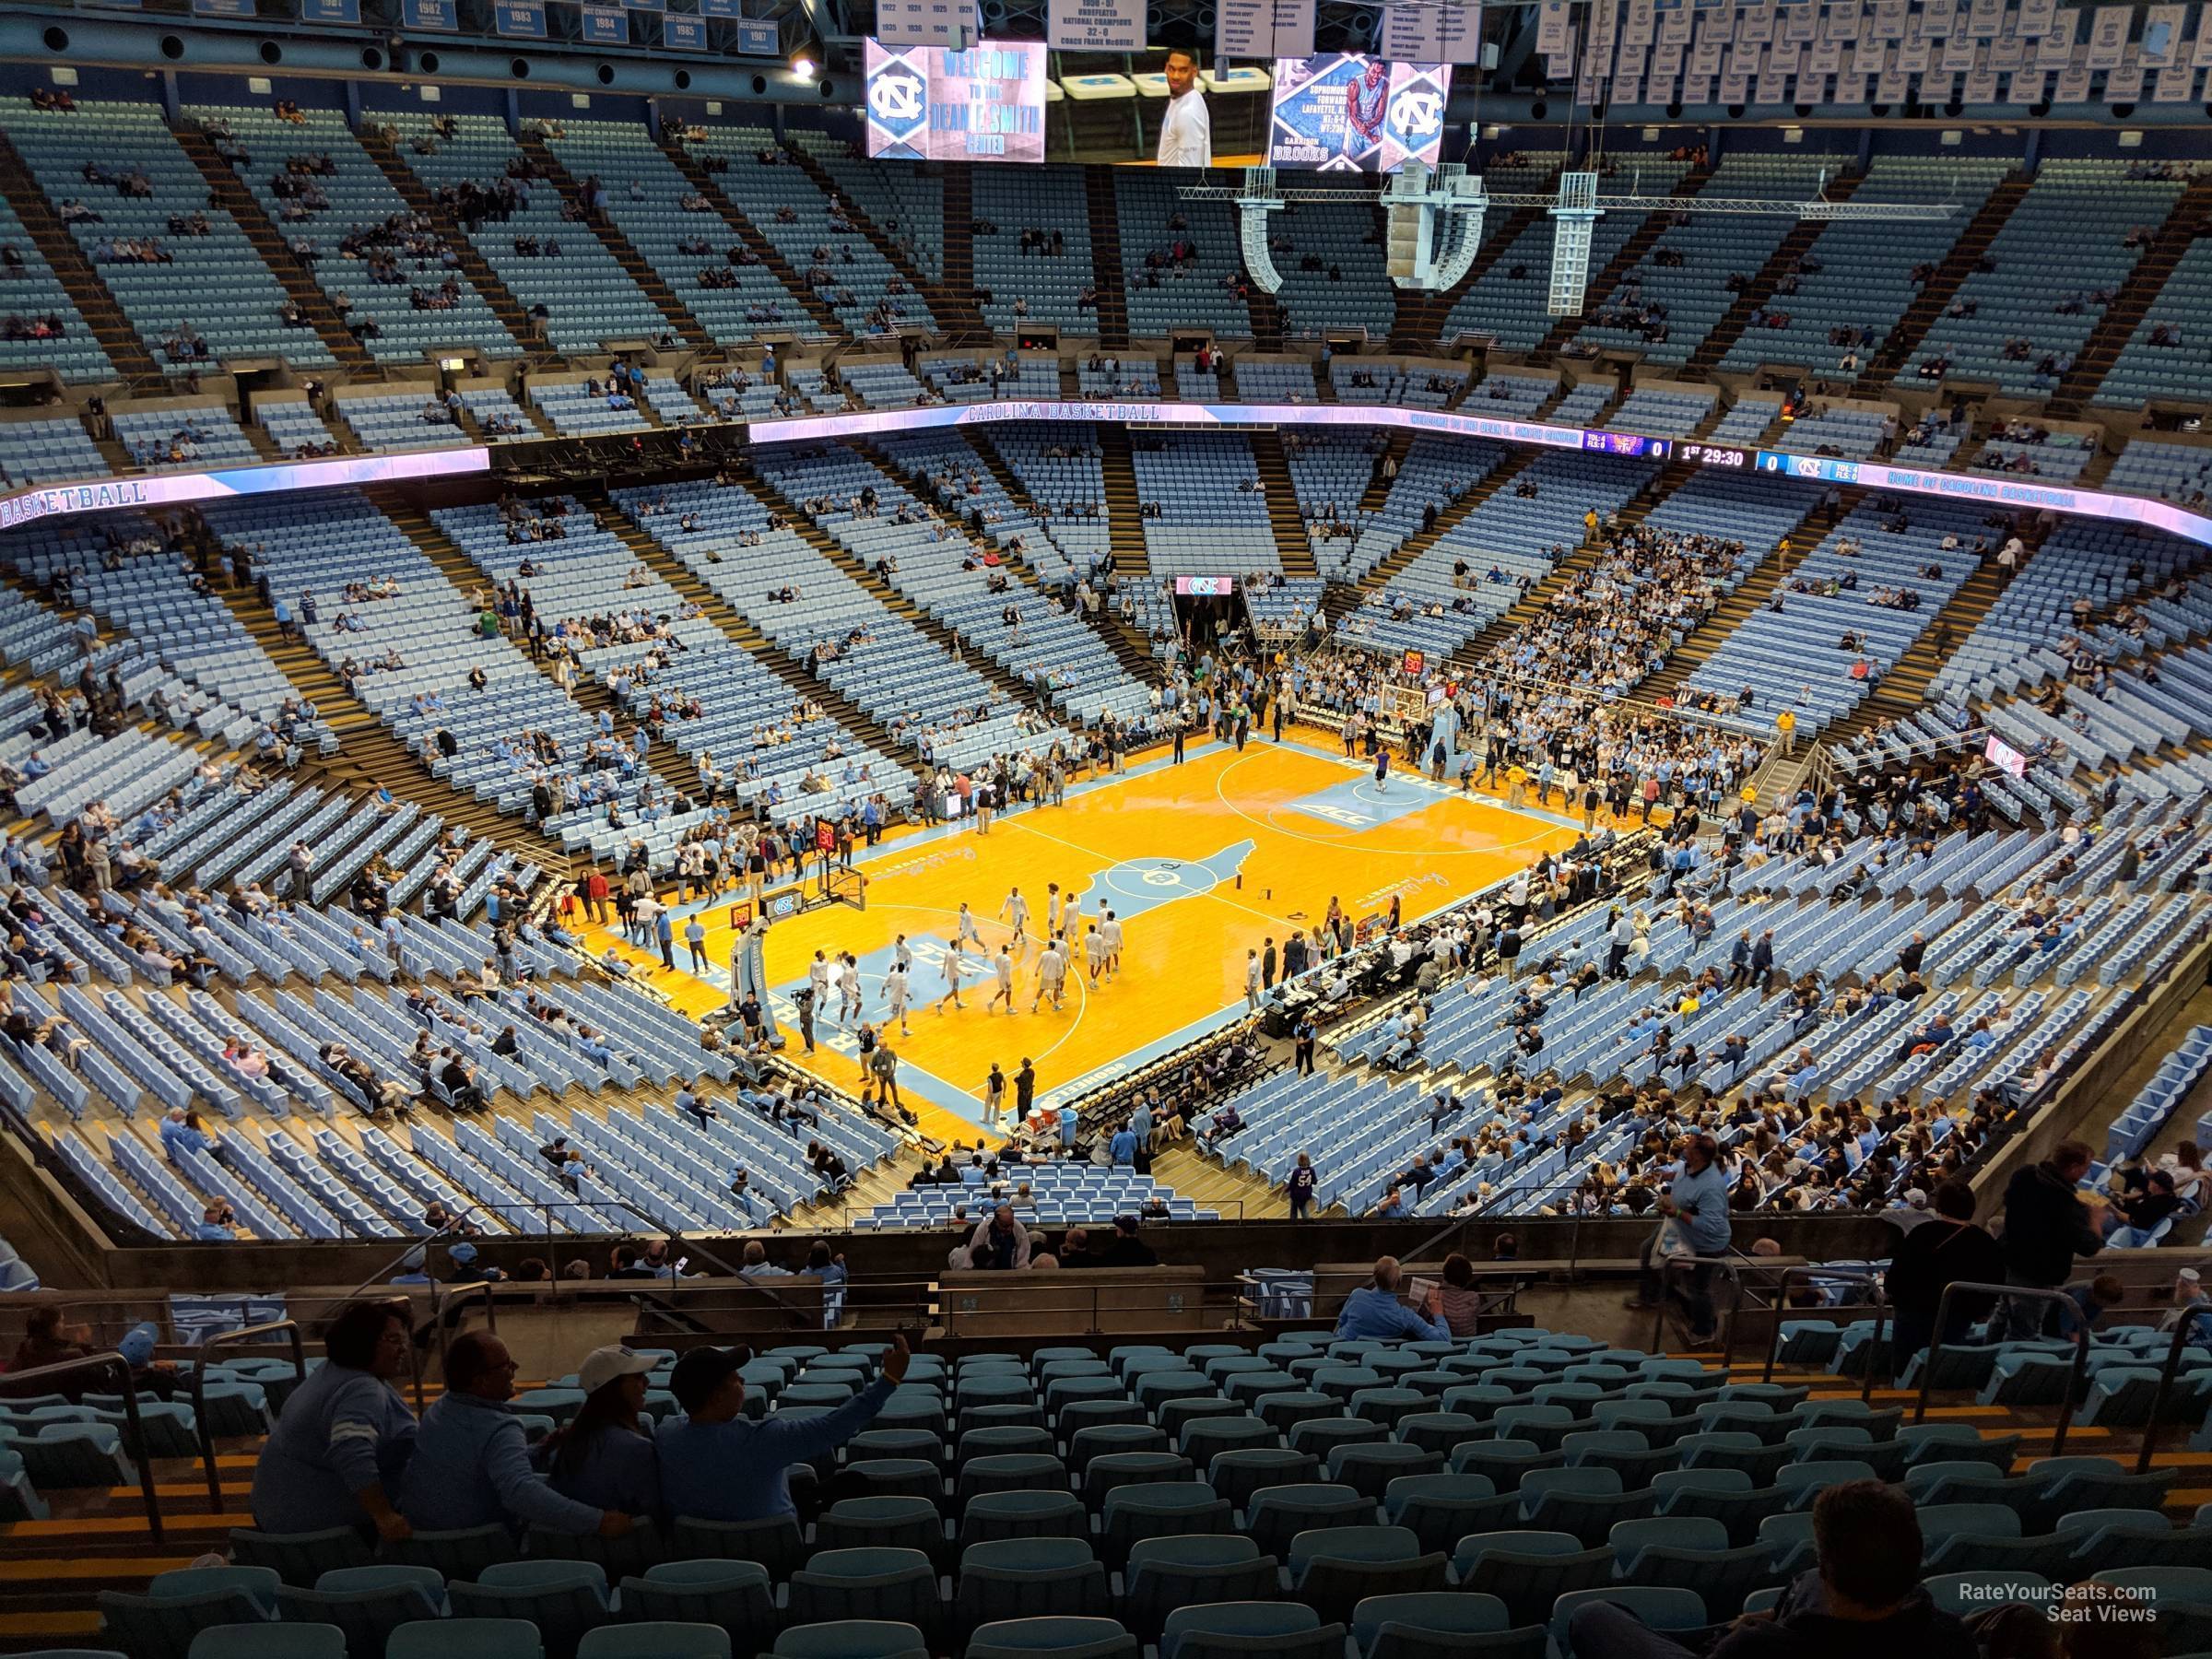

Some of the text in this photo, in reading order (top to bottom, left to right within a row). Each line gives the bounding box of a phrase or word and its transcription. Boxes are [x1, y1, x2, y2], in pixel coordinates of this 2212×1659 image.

[510, 11, 532, 22] 1983
[1078, 8, 1117, 17] UNDEFEATED
[595, 18, 615, 29] 1984
[1087, 28, 1097, 36] 32
[943, 50, 1030, 80] WELCOME
[969, 84, 1003, 100] TO THE
[1310, 85, 1348, 95] SOPHOMORE
[1317, 95, 1347, 105] FORWARD
[931, 103, 969, 132] DEAN
[990, 104, 1040, 134] SMITH
[966, 134, 1005, 155] CENTER
[1285, 137, 1319, 146] GARRISON
[1273, 146, 1329, 161] BROOKS
[969, 404, 1159, 422] CAROLINA BASKETBALL
[1412, 414, 1448, 428] WELCOME
[1451, 418, 1461, 429] TO
[1480, 422, 1500, 434] DEAN
[1515, 426, 1542, 439] SMITH
[1546, 429, 1578, 443] CENTER
[1652, 441, 1663, 456] 0
[1702, 448, 1743, 466] 29:30
[1767, 455, 1778, 471] 0
[1836, 463, 1852, 473] TOL:
[1836, 471, 1850, 480] FLS:
[1888, 471, 2075, 507] HOME OF CAROLINA BASKETBALL
[1, 482, 147, 527] BASKETBALL
[1290, 803, 1379, 826] ACC
[1298, 1174, 1312, 1187] 54
